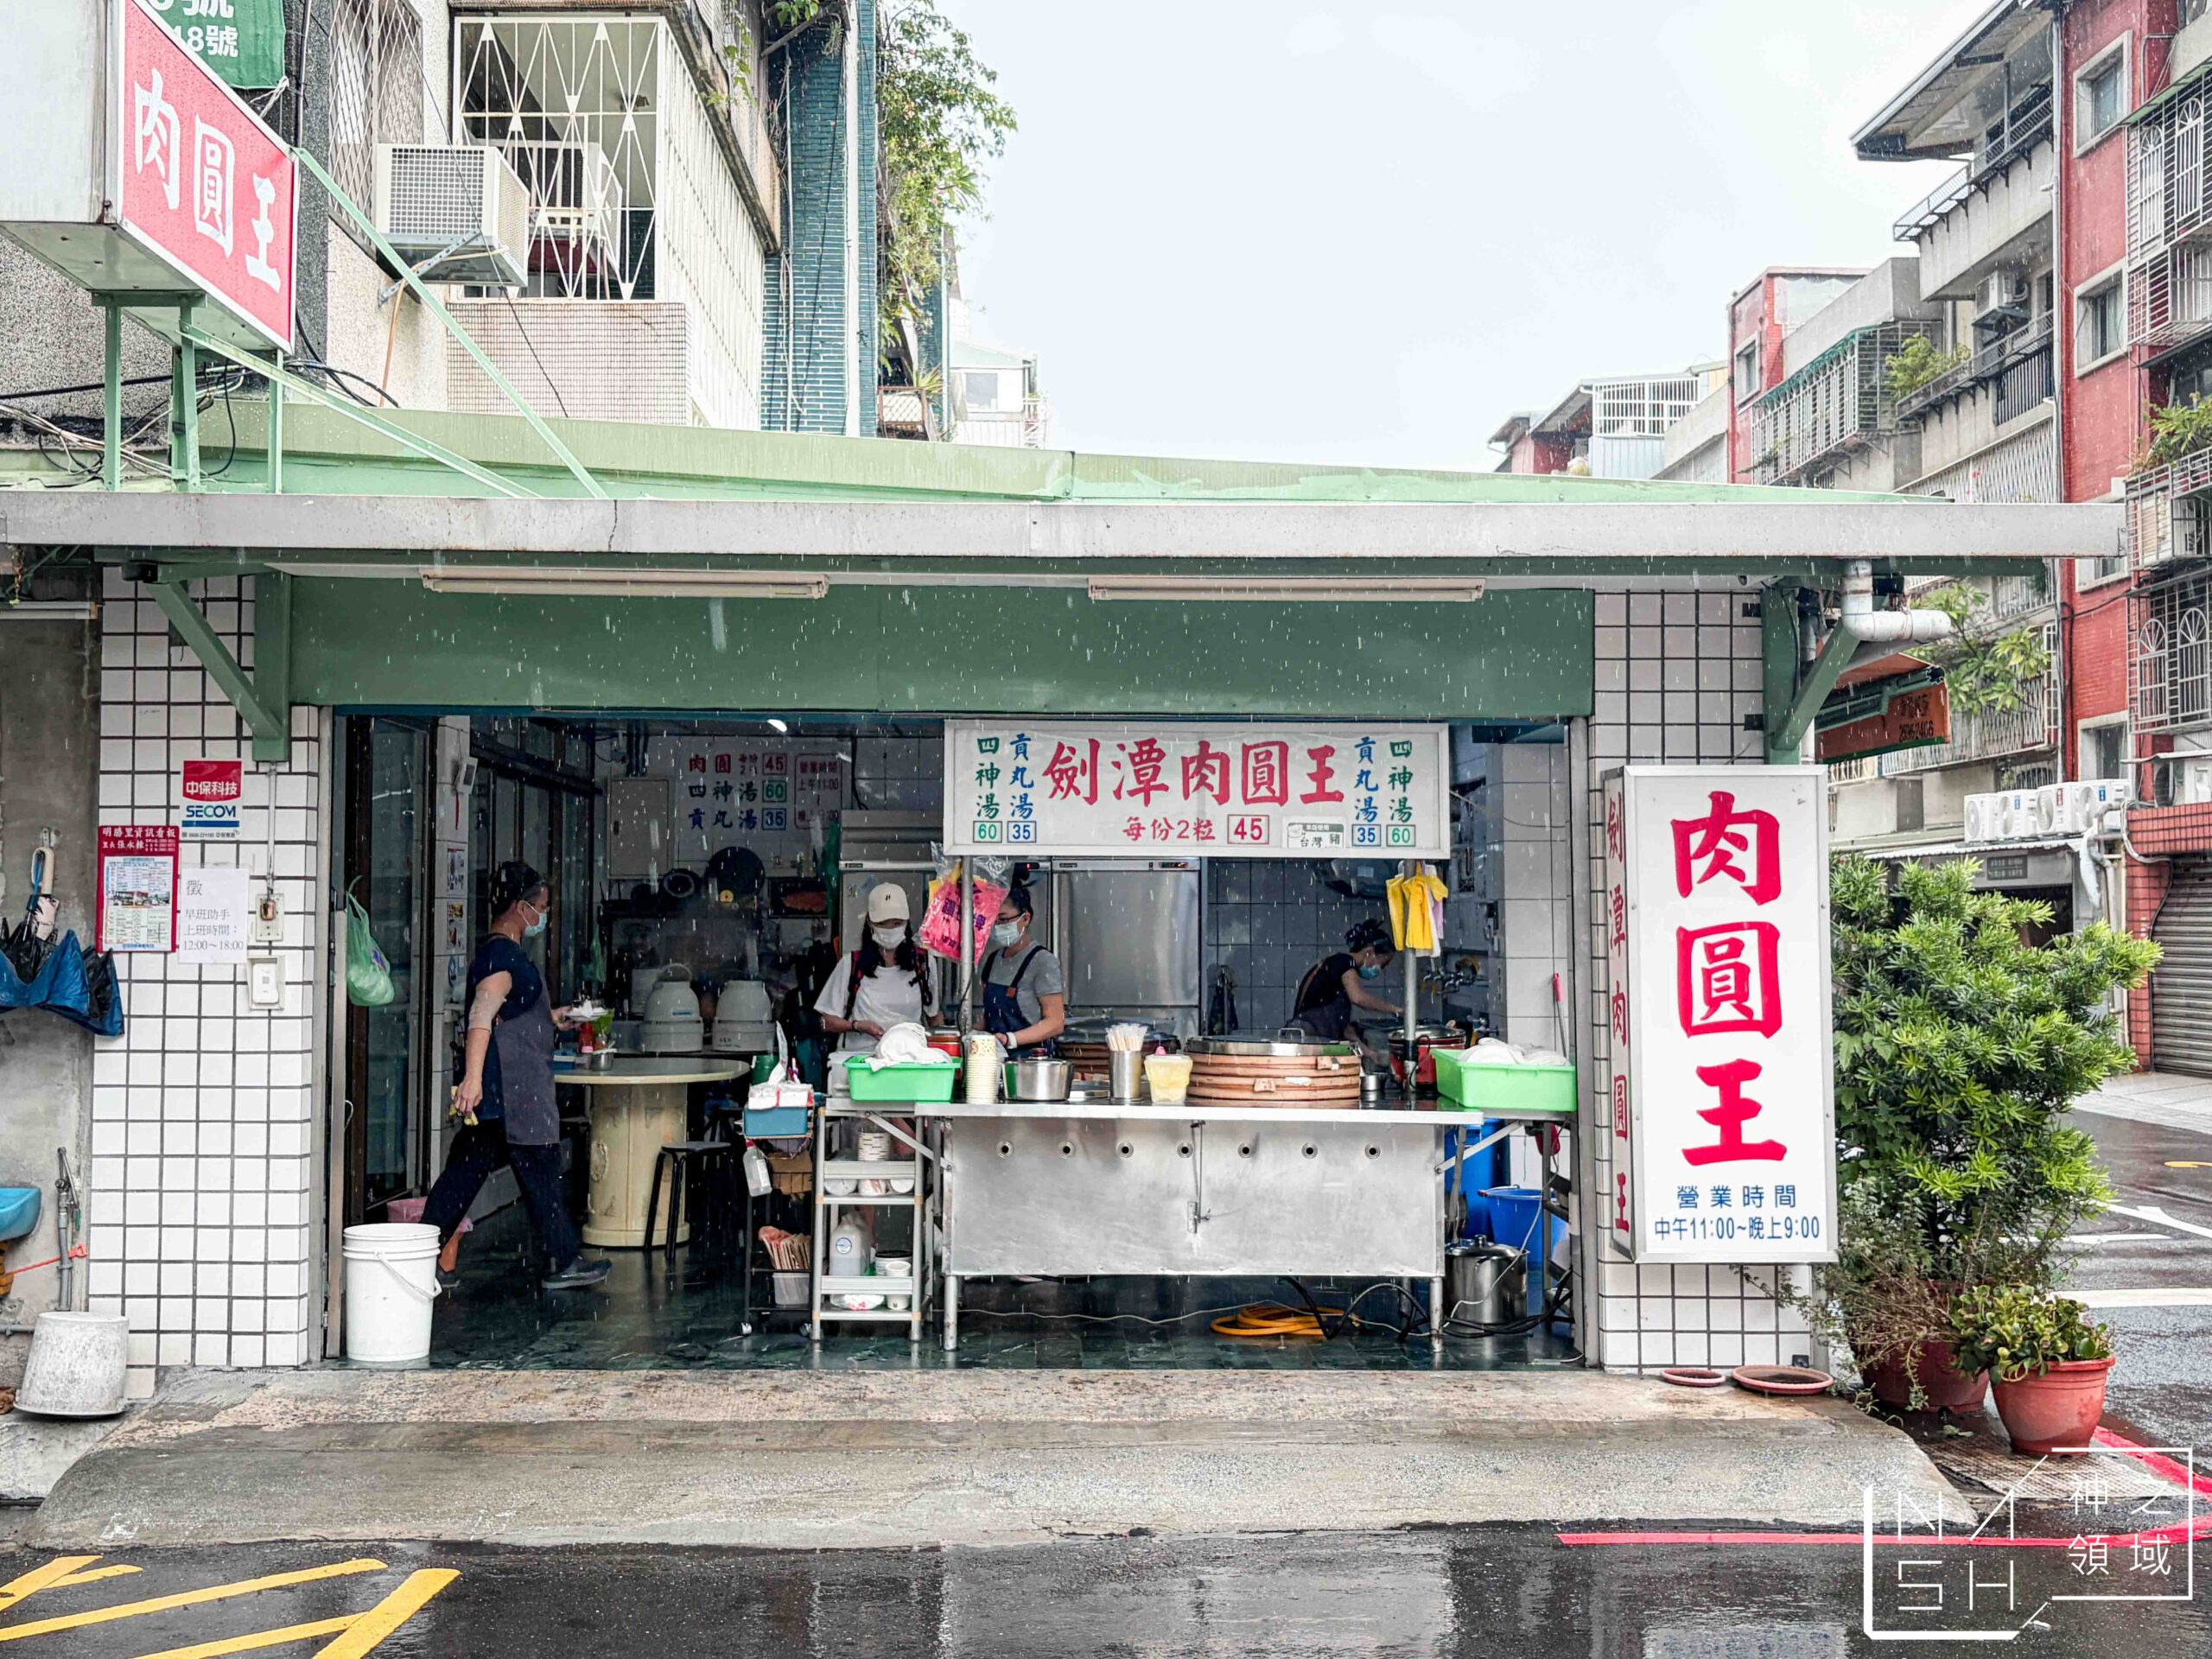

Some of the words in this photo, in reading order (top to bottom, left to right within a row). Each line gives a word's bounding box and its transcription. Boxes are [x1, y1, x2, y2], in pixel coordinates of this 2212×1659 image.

[134, 67, 281, 294] 肉圓王
[689, 753, 732, 774] 肉圓
[766, 756, 784, 772] 45
[1042, 737, 1344, 807] 劍潭肉圓王
[186, 780, 238, 795] 中保科技
[976, 736, 1001, 819] 四神湯
[1009, 733, 1034, 819] 貢丸湯
[1354, 736, 1379, 823] 貢丸湯
[1388, 741, 1414, 823] 四神湯
[688, 779, 758, 803] 四神湯
[765, 785, 784, 799] 60
[186, 804, 236, 817] SECOM
[688, 807, 758, 830] 貢丸湯
[765, 811, 784, 826] 35
[978, 823, 997, 840] 60
[1012, 823, 1031, 840] 35
[1122, 817, 1216, 842] 每份2粒
[1233, 817, 1263, 841] 45
[1357, 827, 1376, 843] 35
[1391, 828, 1411, 843] 60
[183, 908, 231, 920] 早班助手
[1670, 791, 1787, 1166] 肉圓王
[1605, 790, 1630, 1233] 劍潭肉圓王
[1677, 1185, 1796, 1209] 營業時間
